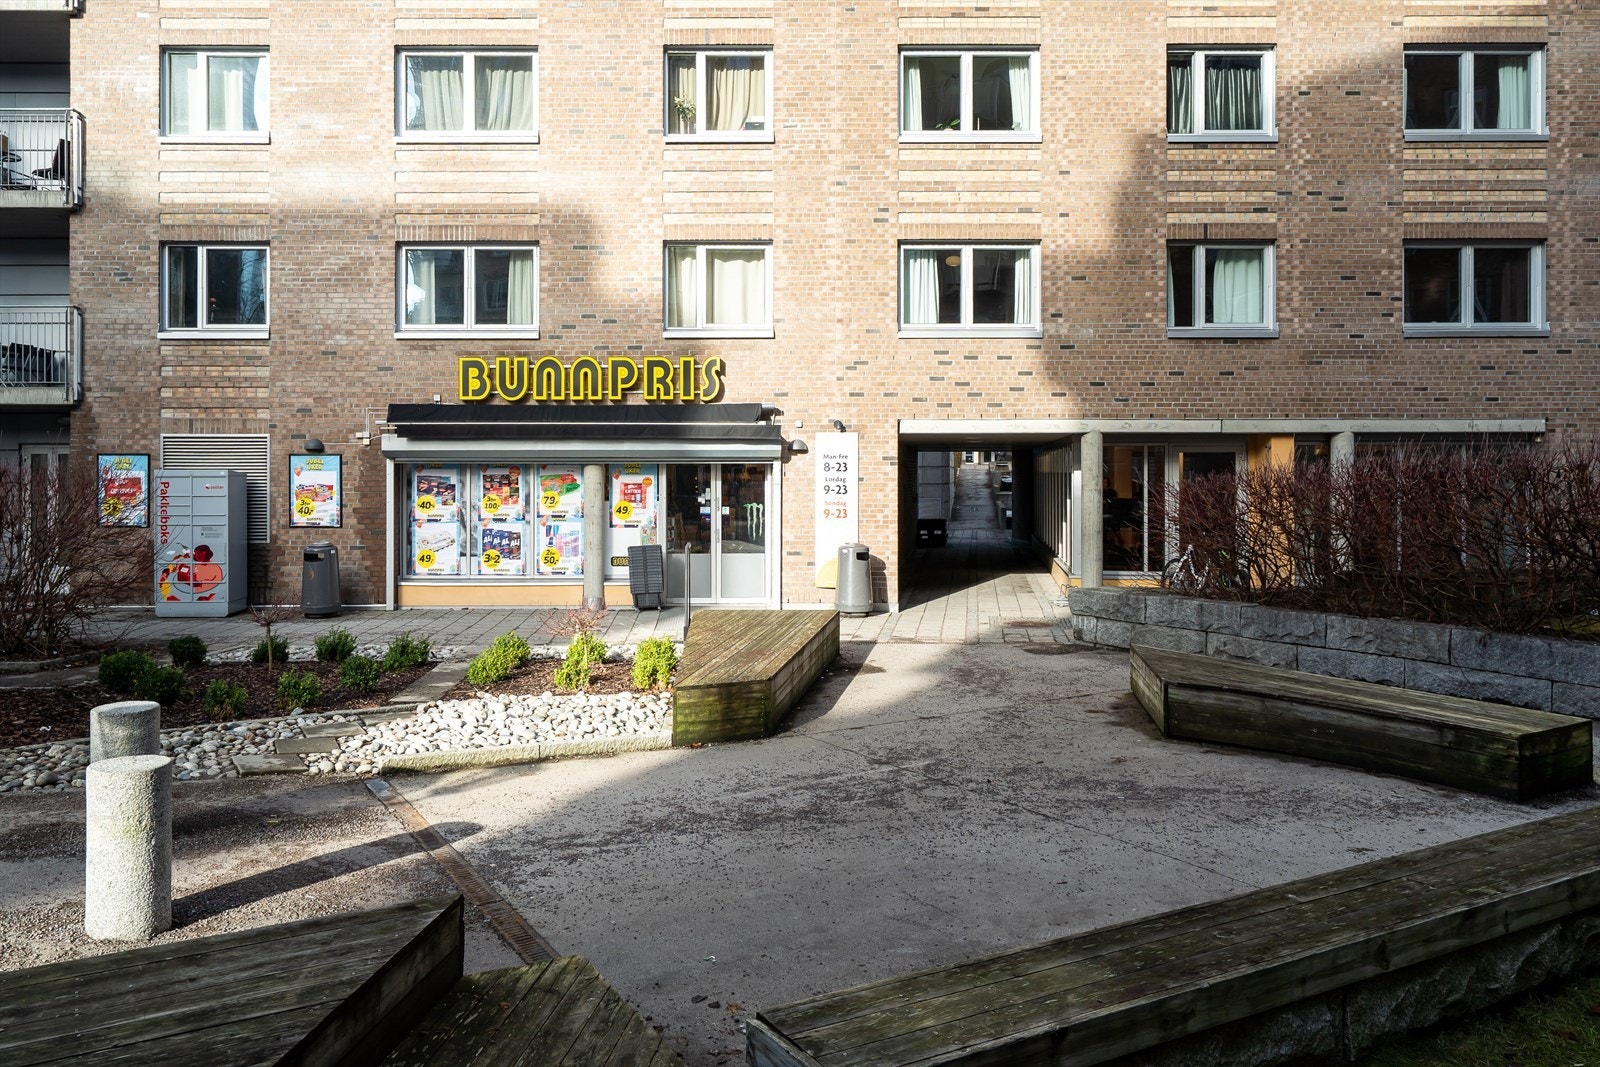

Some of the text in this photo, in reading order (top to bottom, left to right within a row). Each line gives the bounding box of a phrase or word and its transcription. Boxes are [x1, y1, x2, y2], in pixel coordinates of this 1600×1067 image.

[458, 356, 725, 402] BUNNPRIS
[823, 462, 848, 472] 8-23
[823, 485, 848, 494] 9-23
[160, 481, 170, 545] Pakkeboks
[823, 508, 848, 519] 9-23
